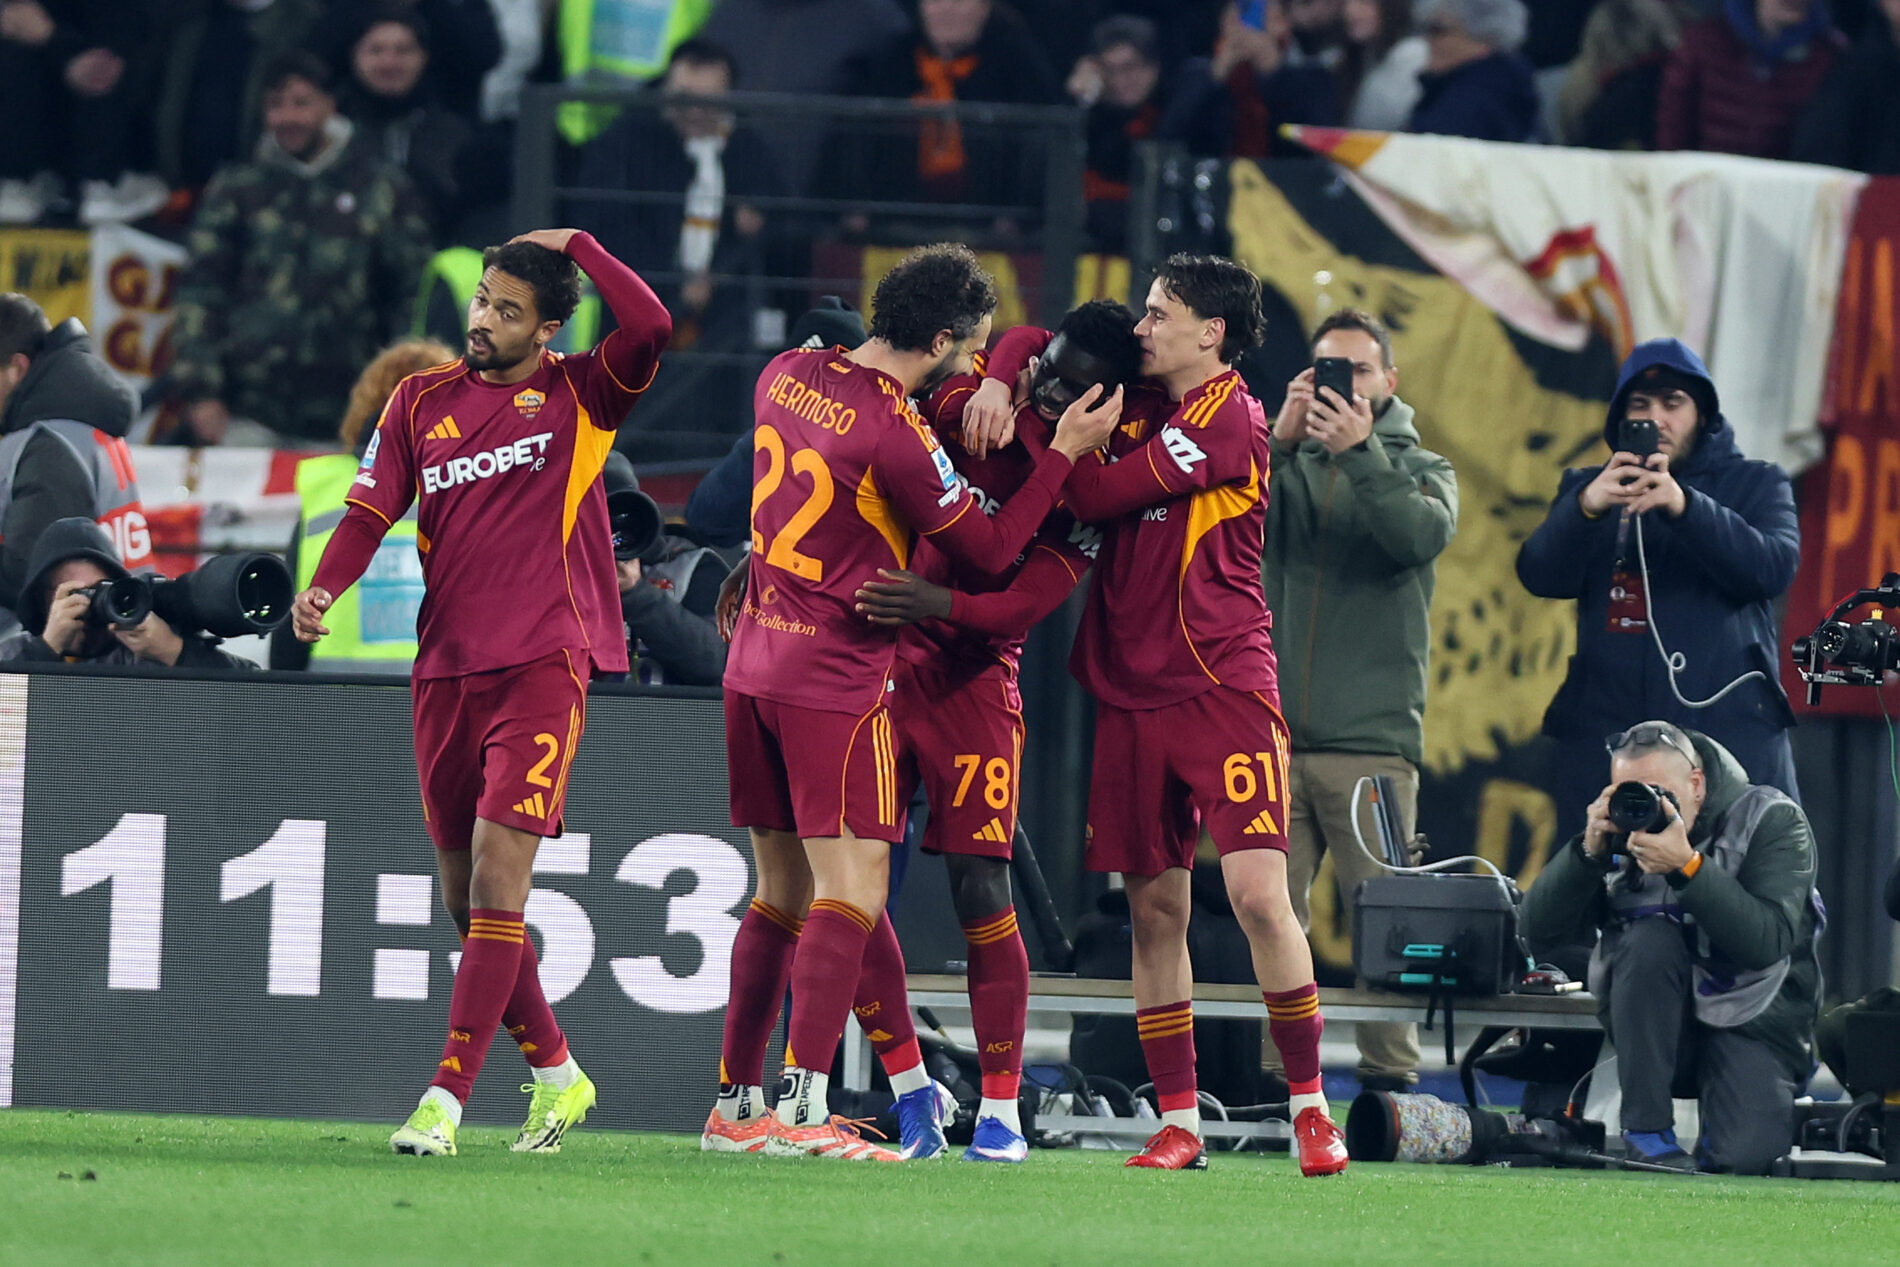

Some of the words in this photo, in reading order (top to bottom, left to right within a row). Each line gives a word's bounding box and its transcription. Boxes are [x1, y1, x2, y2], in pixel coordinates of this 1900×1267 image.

[766, 372, 857, 435] HERMOSO
[422, 432, 553, 494] EUROBET
[751, 424, 834, 582] 22
[526, 733, 559, 788] 2
[953, 754, 1010, 810] 78
[1223, 751, 1277, 803] 61
[60, 812, 748, 1014] 11:53
